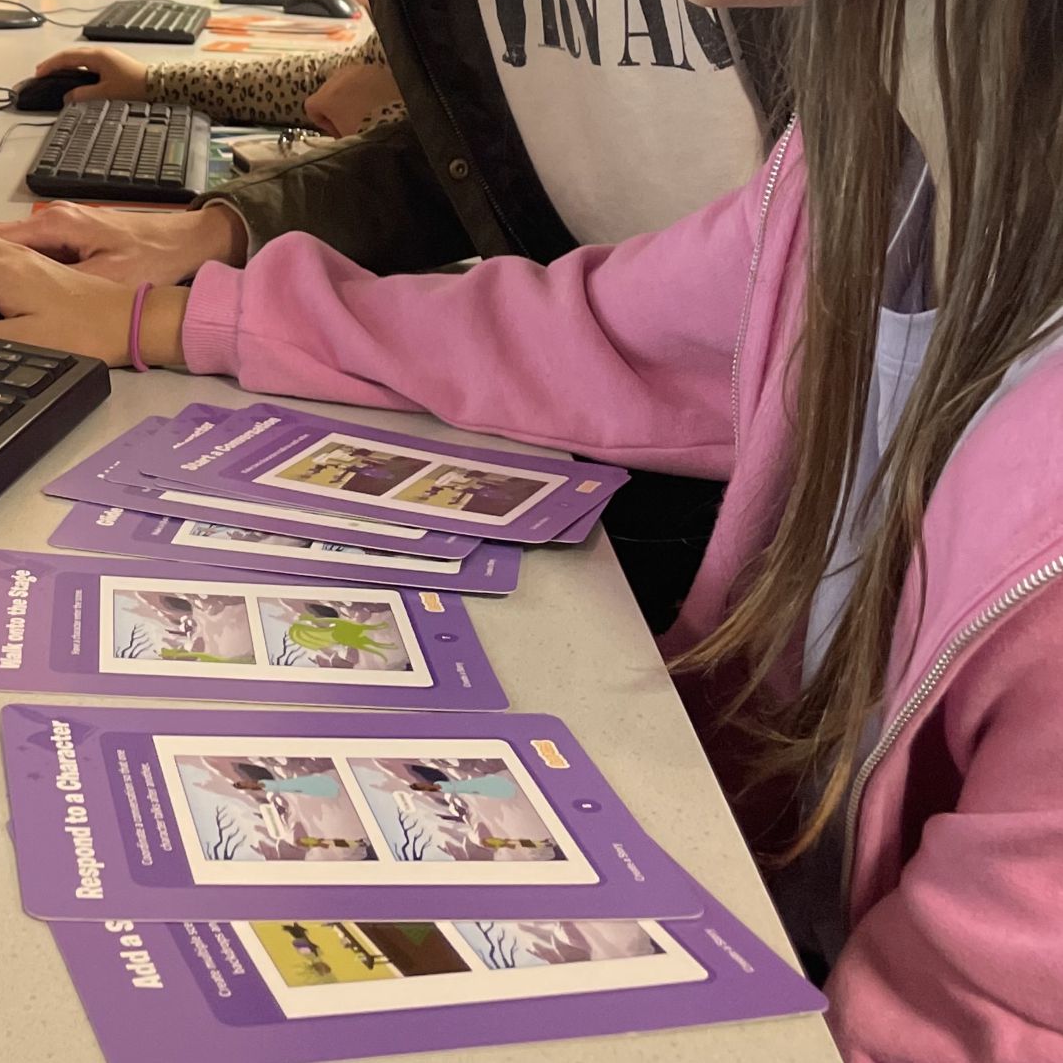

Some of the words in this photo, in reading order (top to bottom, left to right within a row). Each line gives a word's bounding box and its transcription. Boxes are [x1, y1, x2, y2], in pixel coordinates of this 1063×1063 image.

[180, 454, 217, 471] Start
[7, 569, 38, 598] Stage
[6, 598, 28, 616] the
[5, 617, 26, 642] onto
[0, 642, 24, 669] Walk
[50, 720, 82, 791] Character
[116, 749, 128, 762] one
[118, 761, 131, 774] that
[122, 774, 133, 783] so
[65, 793, 85, 804] a
[124, 782, 143, 823] conversation
[146, 788, 159, 803] after
[65, 805, 88, 824] to
[150, 803, 164, 820] talks
[136, 827, 153, 866] Coordinate
[156, 820, 173, 852] character
[65, 826, 105, 899] Respond
[119, 934, 143, 948] a
[190, 935, 216, 970] multiple
[120, 949, 164, 989] Add
[210, 969, 232, 998] Create
